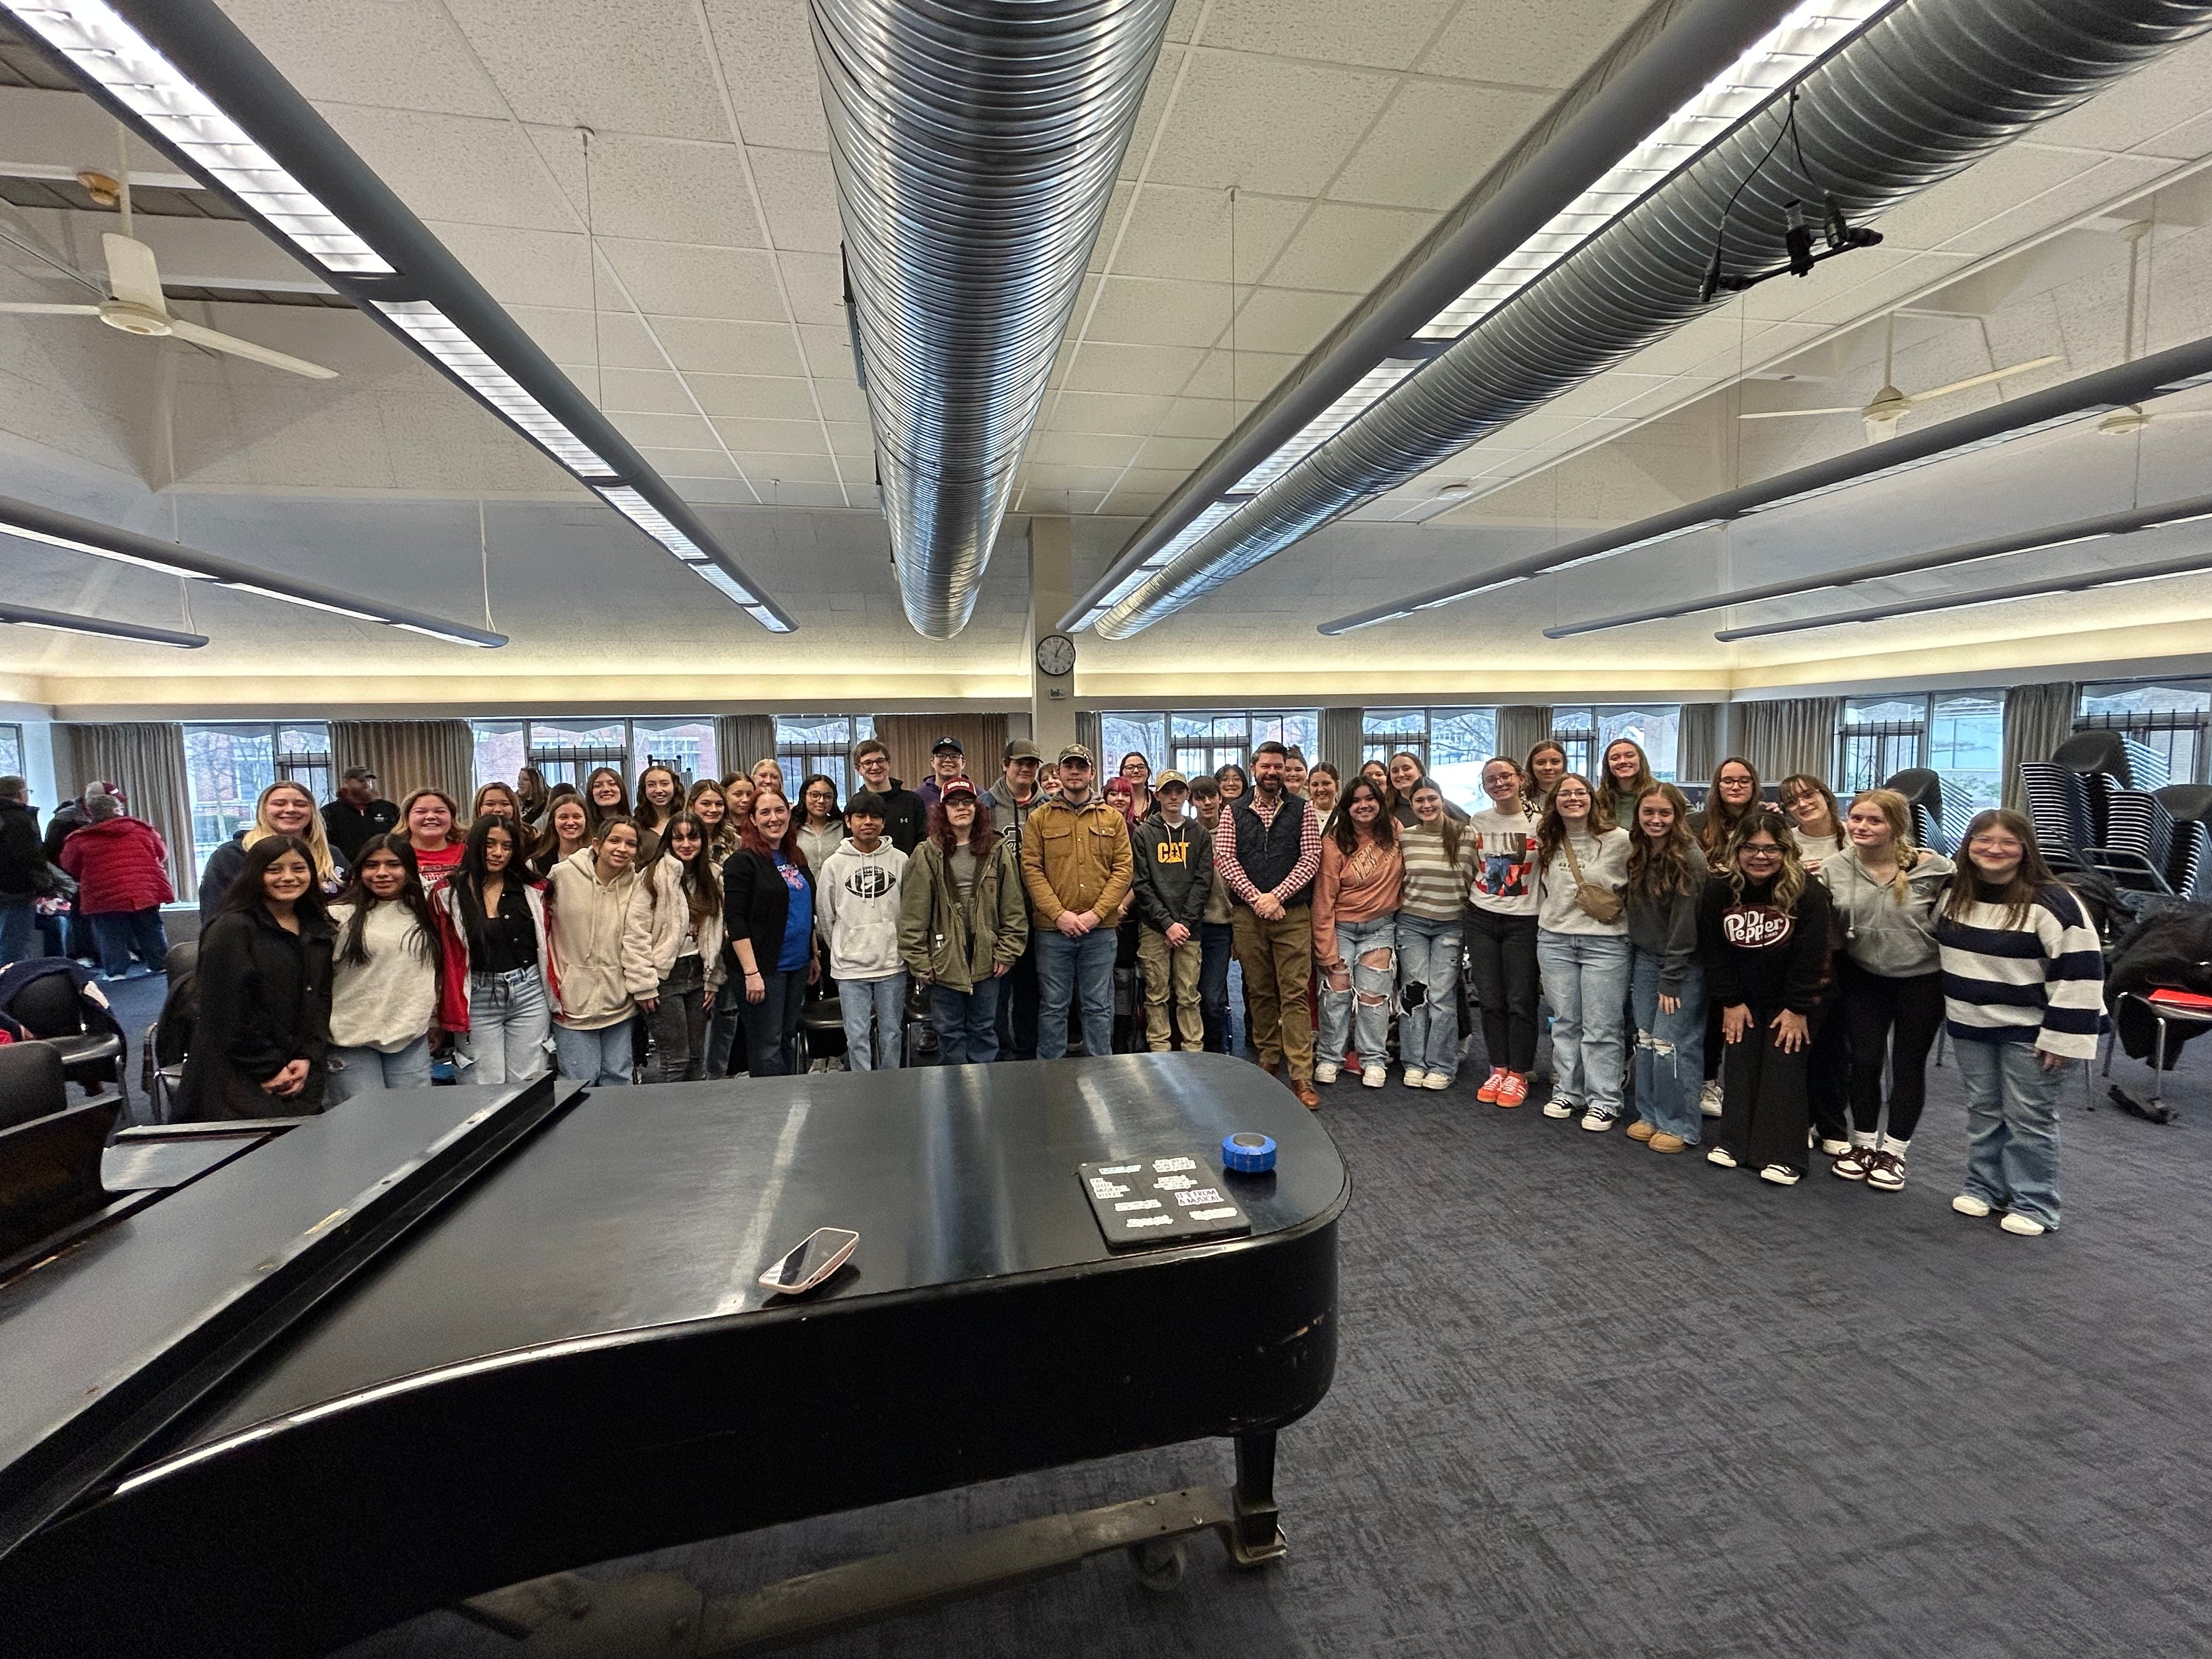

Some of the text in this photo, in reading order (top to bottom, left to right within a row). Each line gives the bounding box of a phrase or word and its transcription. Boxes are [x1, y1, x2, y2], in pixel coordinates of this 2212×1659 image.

[1157, 842, 1189, 864] CAT
[1351, 843, 1379, 884] NEW
[1724, 913, 1784, 943] Pepper
[1187, 1195, 1220, 1204] MUSICAL
